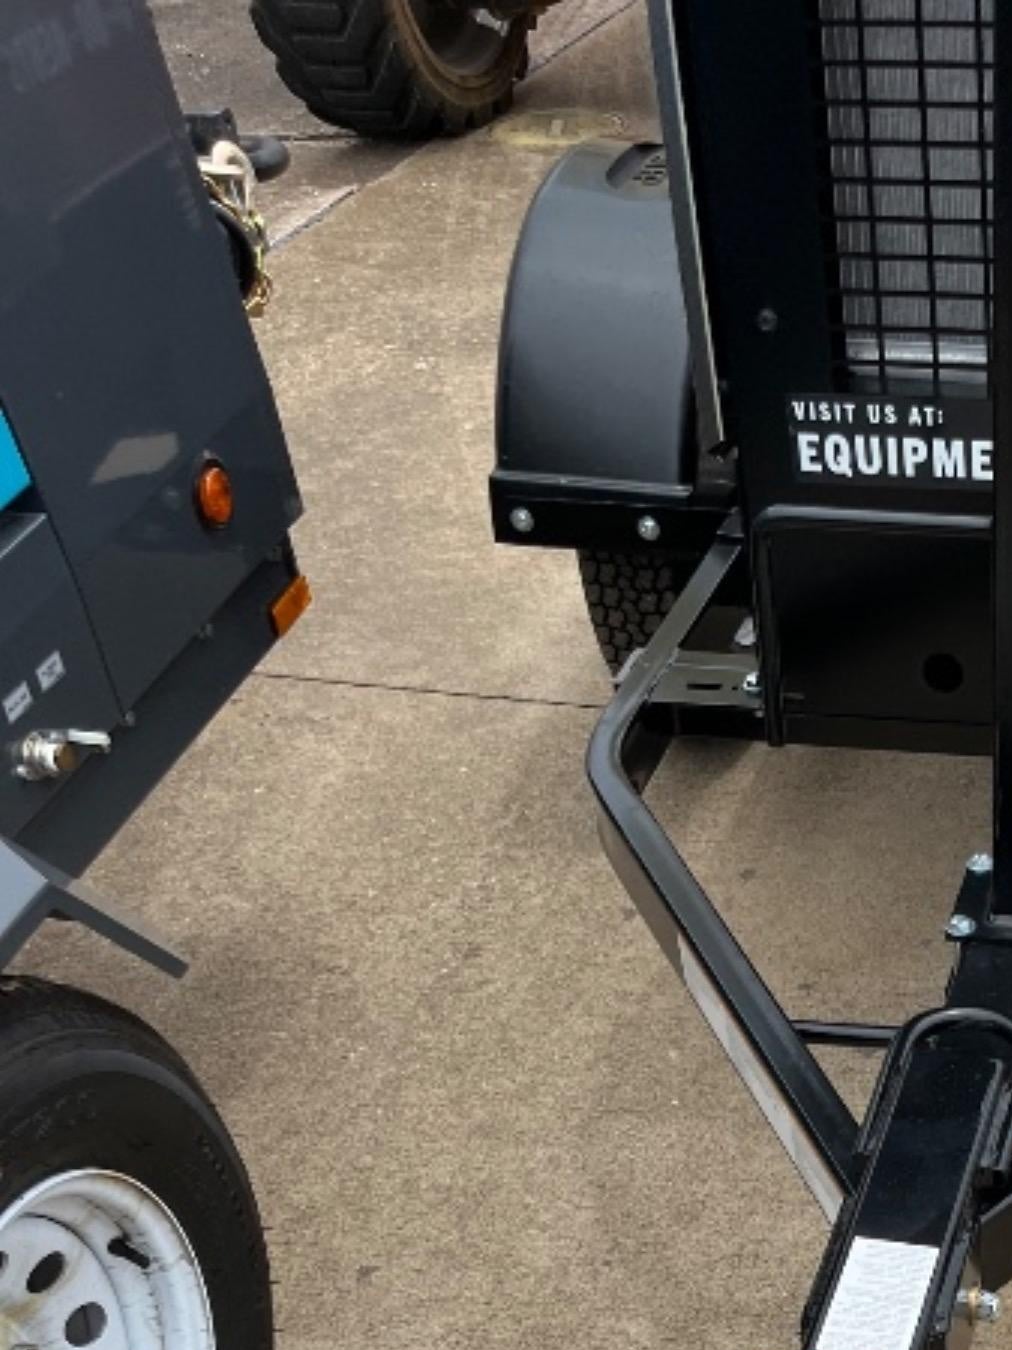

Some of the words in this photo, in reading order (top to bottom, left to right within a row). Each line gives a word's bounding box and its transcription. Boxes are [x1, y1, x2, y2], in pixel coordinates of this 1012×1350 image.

[791, 400, 856, 424] VISIT
[866, 403, 898, 424] US
[908, 405, 944, 427] AT:
